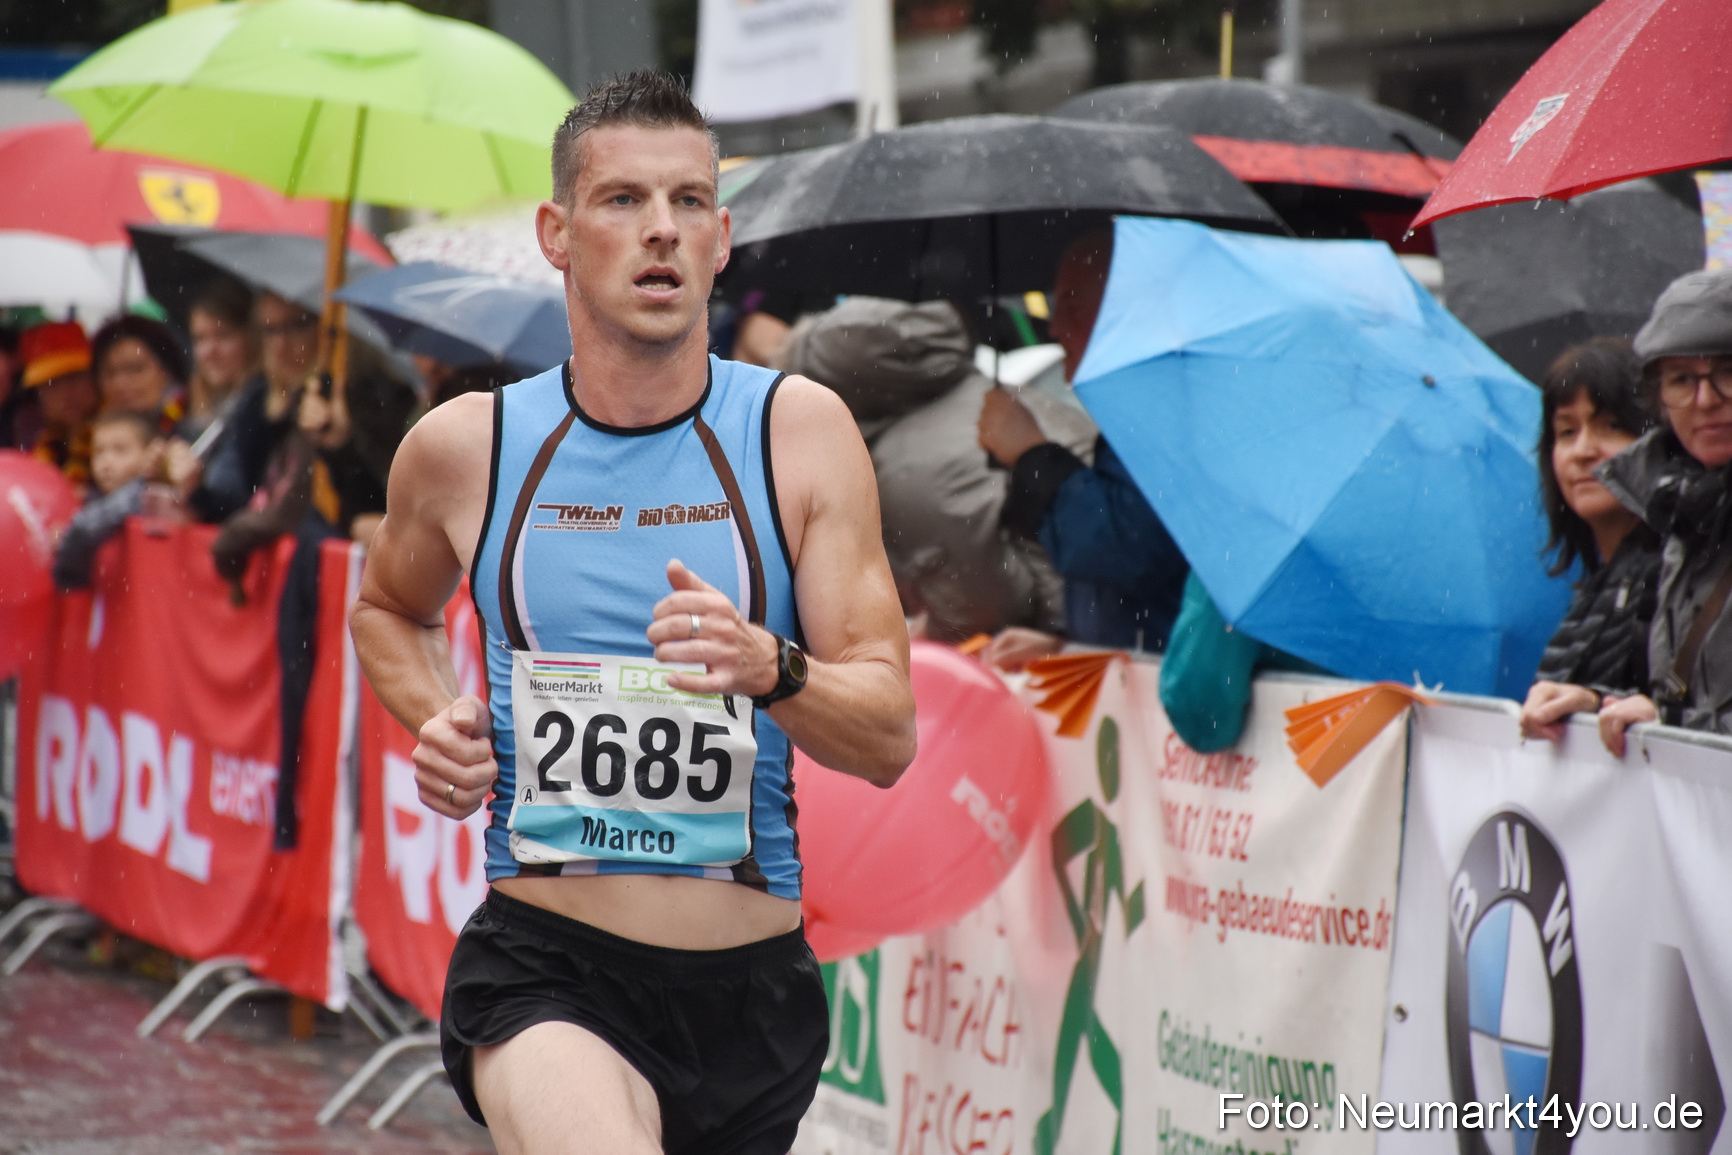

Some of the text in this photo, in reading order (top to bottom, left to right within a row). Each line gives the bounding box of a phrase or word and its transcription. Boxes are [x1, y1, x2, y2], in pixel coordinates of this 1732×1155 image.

[687, 501, 731, 524] RACER
[529, 678, 603, 694] NeuerMarkt
[617, 694, 728, 713] inspired by smart concep
[532, 709, 733, 802] 2685
[523, 787, 534, 803] A
[581, 816, 675, 855] Marco
[1452, 820, 1573, 978] BMW
